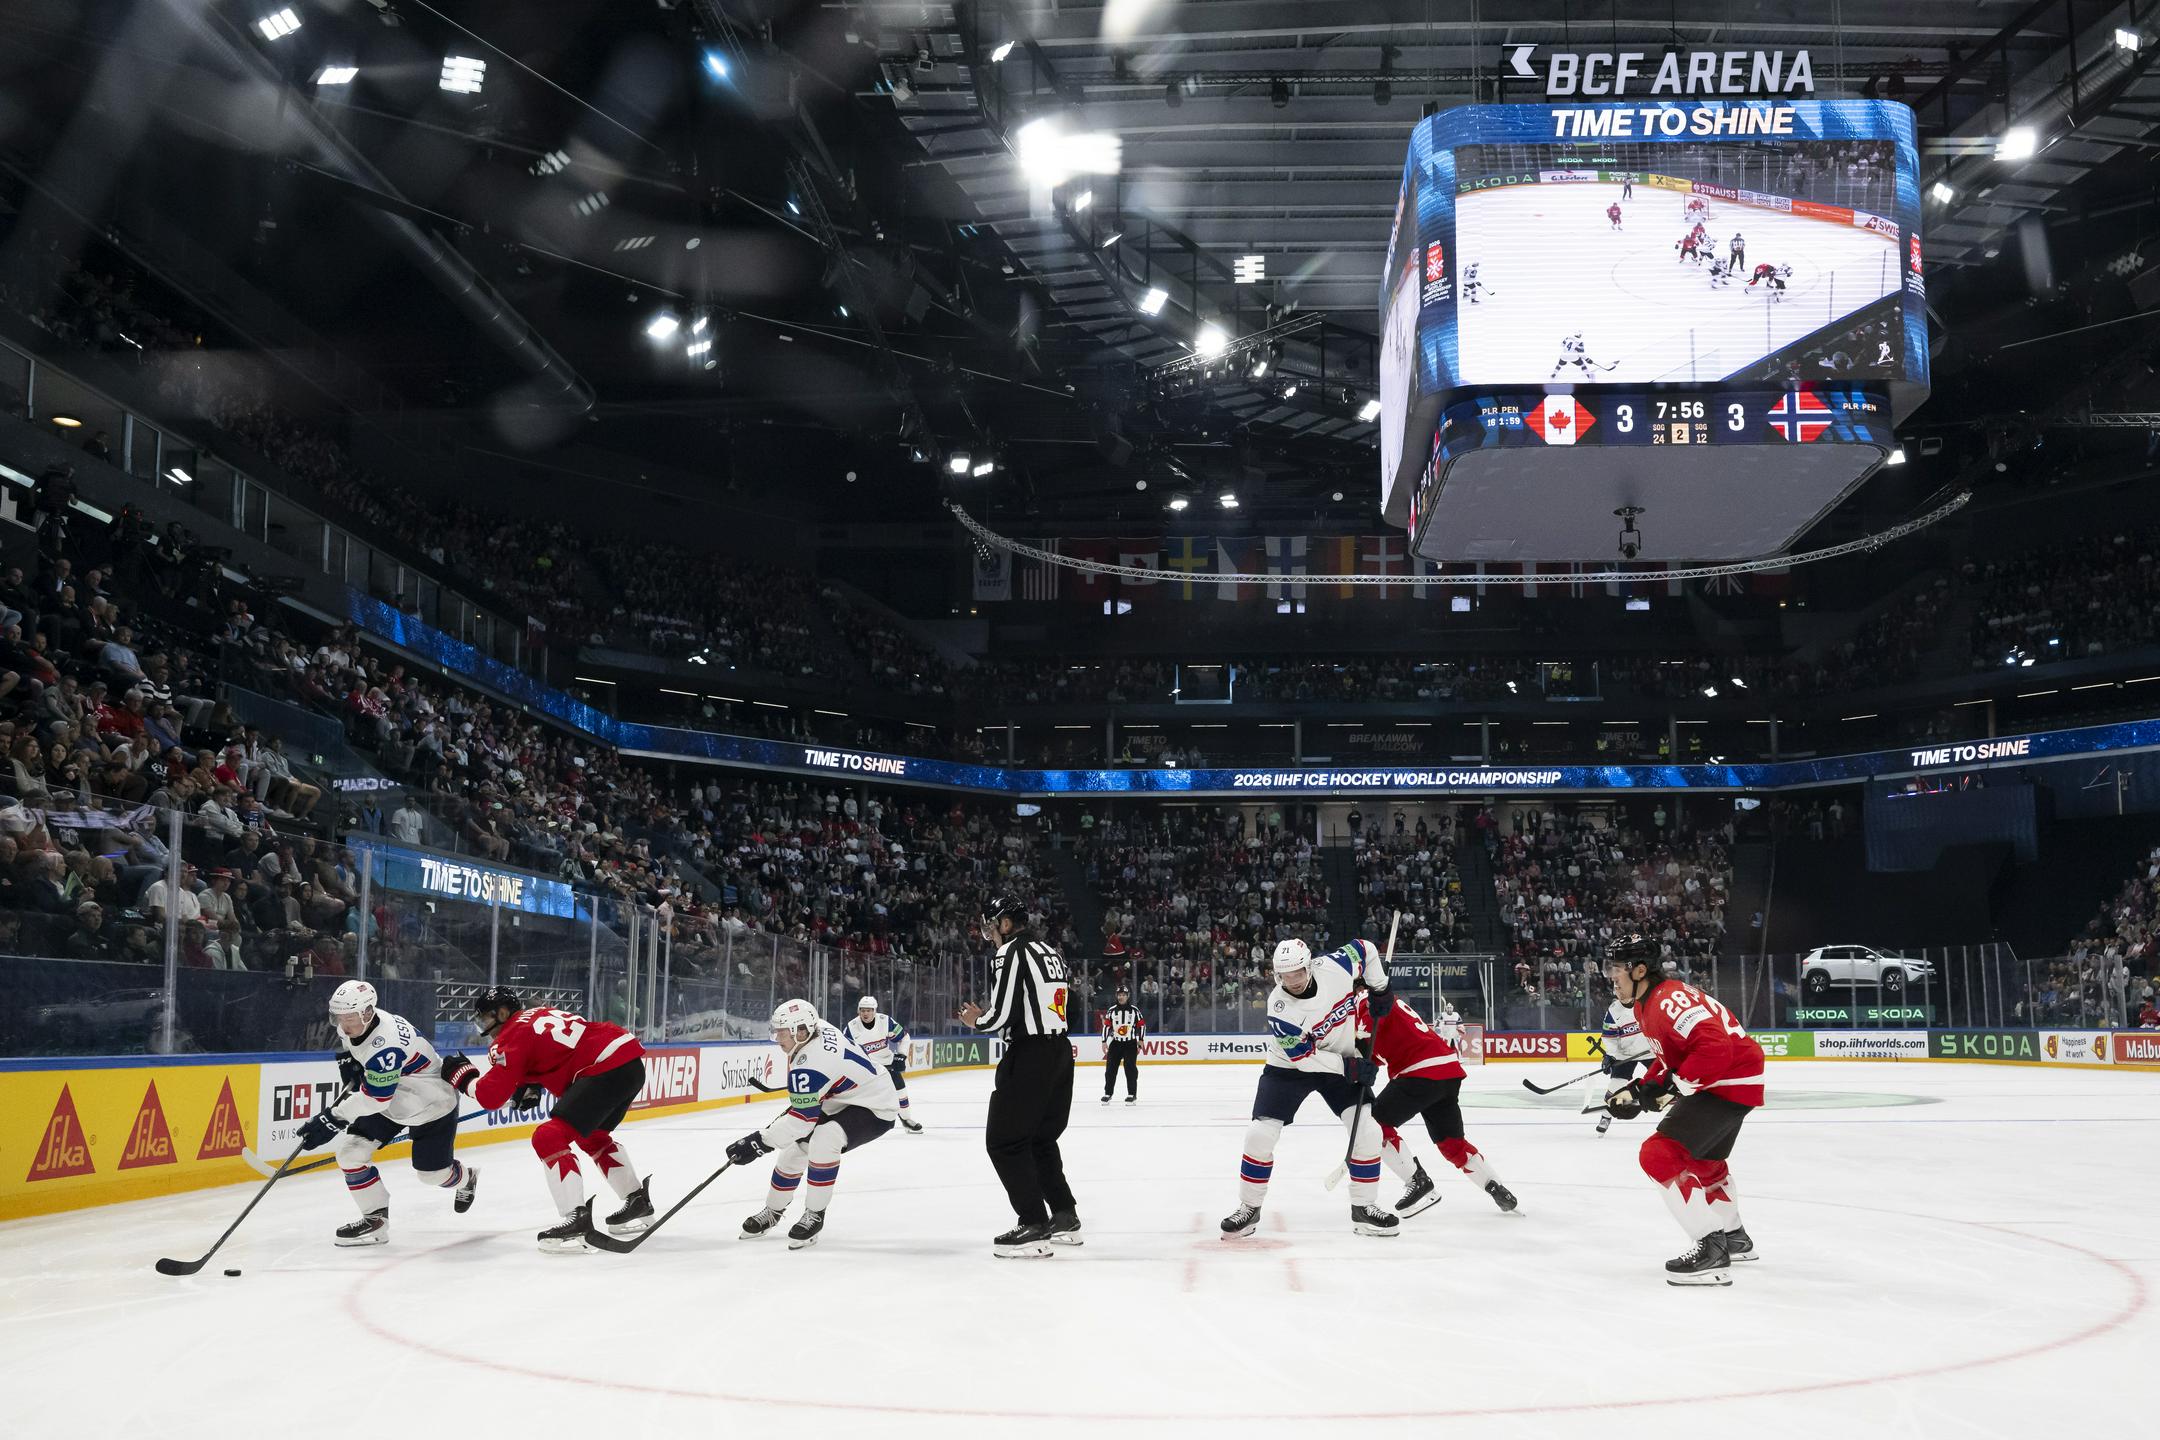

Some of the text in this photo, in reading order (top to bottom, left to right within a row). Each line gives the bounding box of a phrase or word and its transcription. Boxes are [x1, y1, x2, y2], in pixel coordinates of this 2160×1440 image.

[1546, 50, 1815, 96] BCF ARENA
[1552, 107, 1796, 137] TIME TO SHINE
[1700, 184, 1736, 199] STRAUSS
[1482, 406, 1519, 416] PLR PEN
[1656, 401, 1705, 419] 7:56
[1842, 402, 1877, 411] PLR PEN
[1487, 416, 1521, 427] 16 1:59
[1616, 404, 1634, 433] 3
[1727, 403, 1745, 432] 3
[1652, 423, 1665, 431] SOG
[1676, 429, 1684, 440] 2
[1694, 423, 1708, 431] SOG
[1653, 434, 1665, 444] 24
[1696, 433, 1707, 443] 12
[1348, 734, 1415, 743] BREAKAWAY
[1911, 739, 2031, 767] TIME TO SHINE
[805, 749, 906, 775] TIME TO SHINE
[1233, 771, 1562, 787] 2026 IIHF ICE HOCKEY WORLD CHAMPIONSHIP
[420, 858, 524, 906] TIME TO SHINE
[995, 957, 1005, 969] 68
[1043, 955, 1064, 980] 68
[1414, 966, 1431, 977] TO
[1432, 965, 1468, 977] SHINE
[1660, 990, 1691, 1020] 28
[1314, 997, 1355, 1037] NORGE
[1138, 1040, 1189, 1056] WISS
[1471, 1037, 1562, 1054] STRAUSS
[1819, 1037, 1926, 1050] shop.iihfworlds.com
[2061, 1036, 2087, 1047] Happiness
[1763, 1045, 1789, 1056] ES
[2065, 1050, 2072, 1058] at
[791, 1072, 811, 1093] 12
[126, 1108, 169, 1161] Sika
[204, 1103, 241, 1152] Sika
[36, 1115, 85, 1172] Sika
